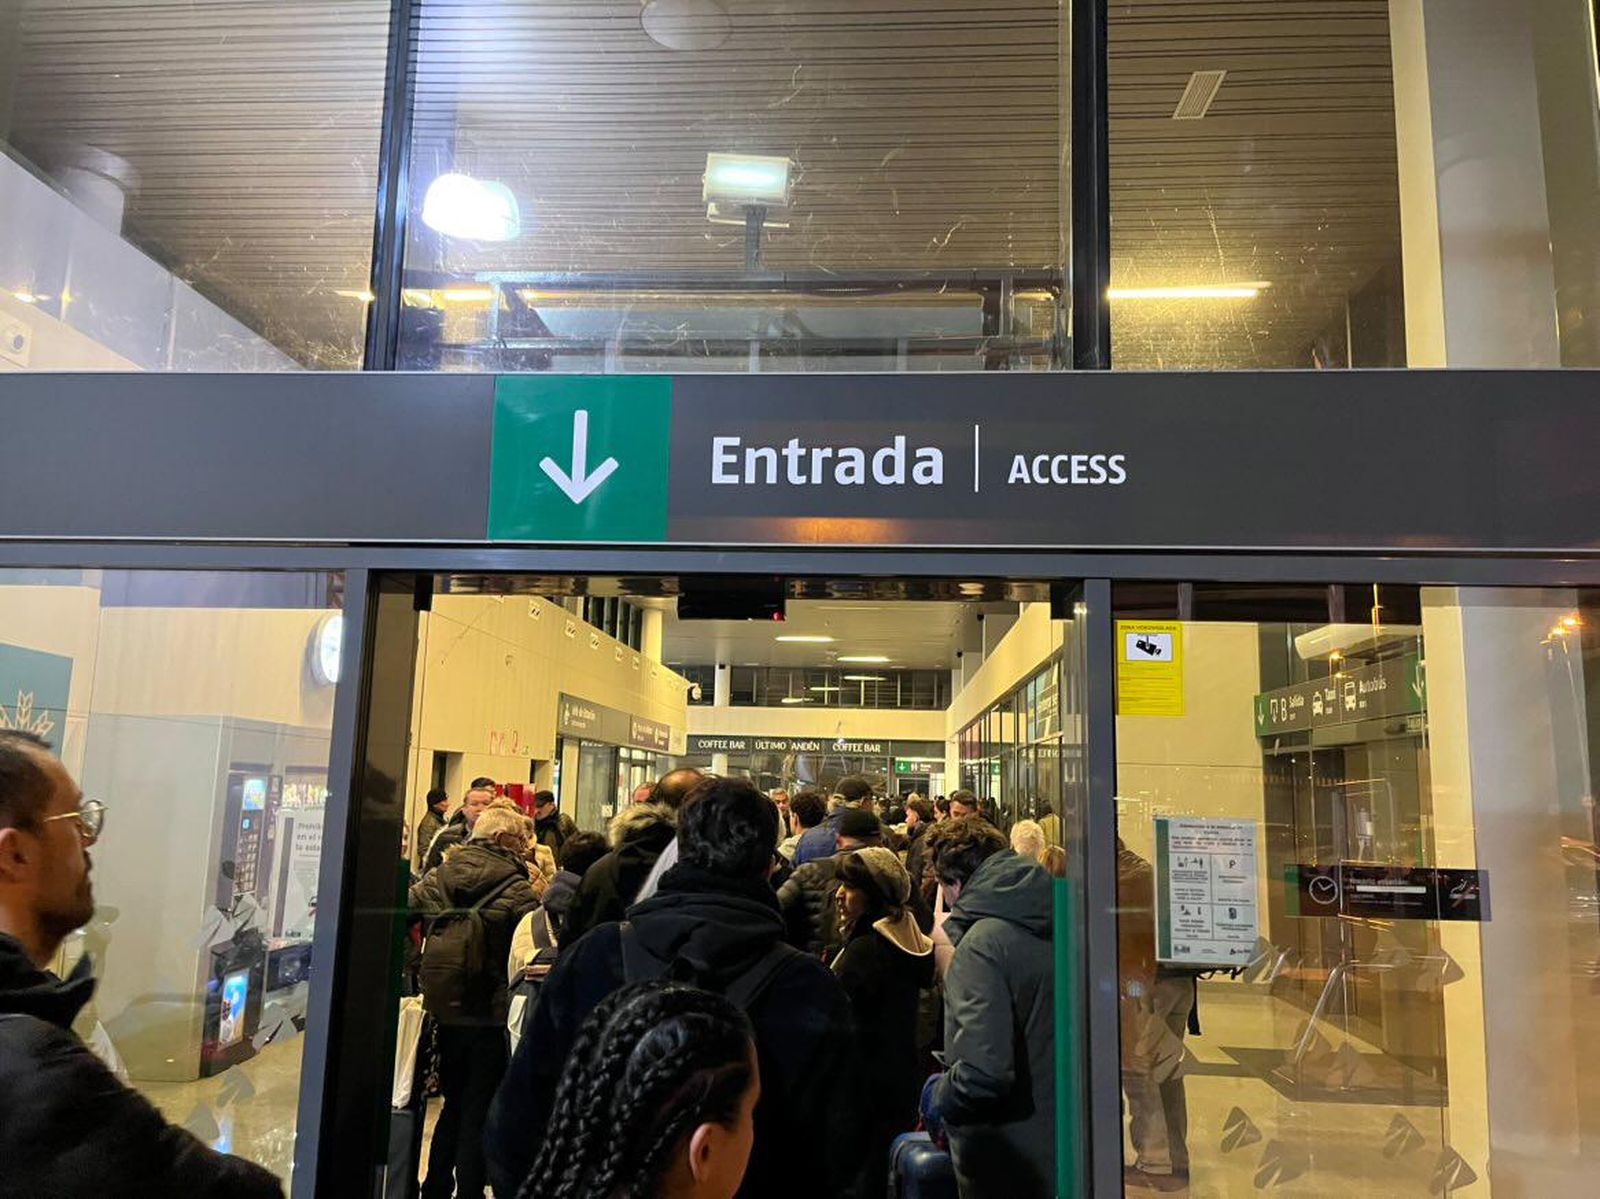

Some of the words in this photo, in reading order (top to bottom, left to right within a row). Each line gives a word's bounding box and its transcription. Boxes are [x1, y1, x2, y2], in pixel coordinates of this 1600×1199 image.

[711, 435, 944, 485] Entrada
[1007, 454, 1127, 485] ACCESS
[698, 740, 728, 749] COFFEE
[729, 741, 746, 749] BAR
[791, 741, 820, 751] ANDÉN
[832, 742, 863, 752] COFFEE
[864, 743, 881, 753] BAR
